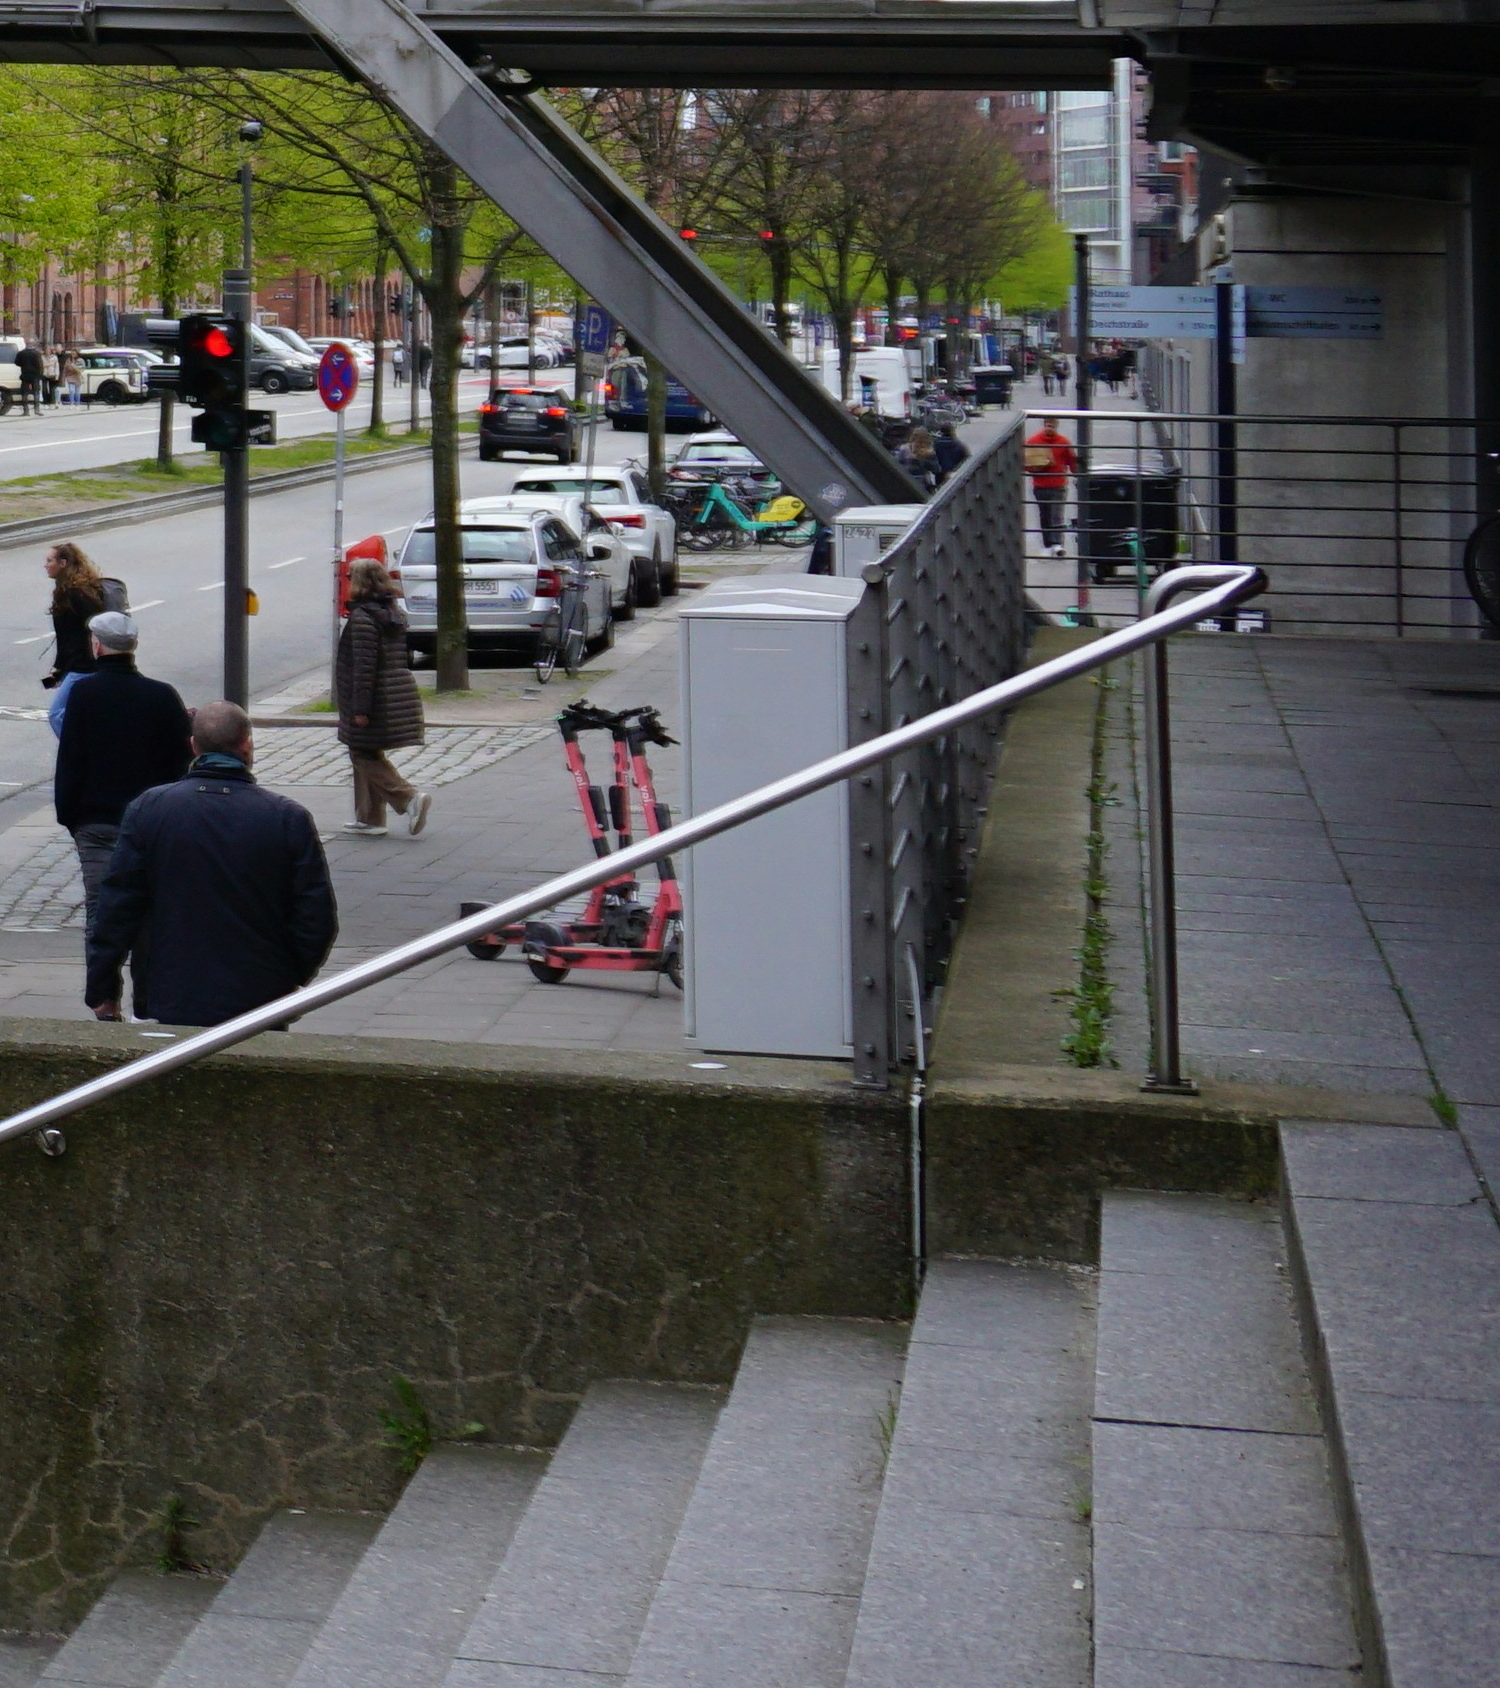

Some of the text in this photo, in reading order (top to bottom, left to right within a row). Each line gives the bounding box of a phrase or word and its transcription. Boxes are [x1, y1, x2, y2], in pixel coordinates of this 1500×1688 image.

[1269, 293, 1285, 303] WC
[588, 313, 601, 346] P
[845, 527, 875, 539] 2422
